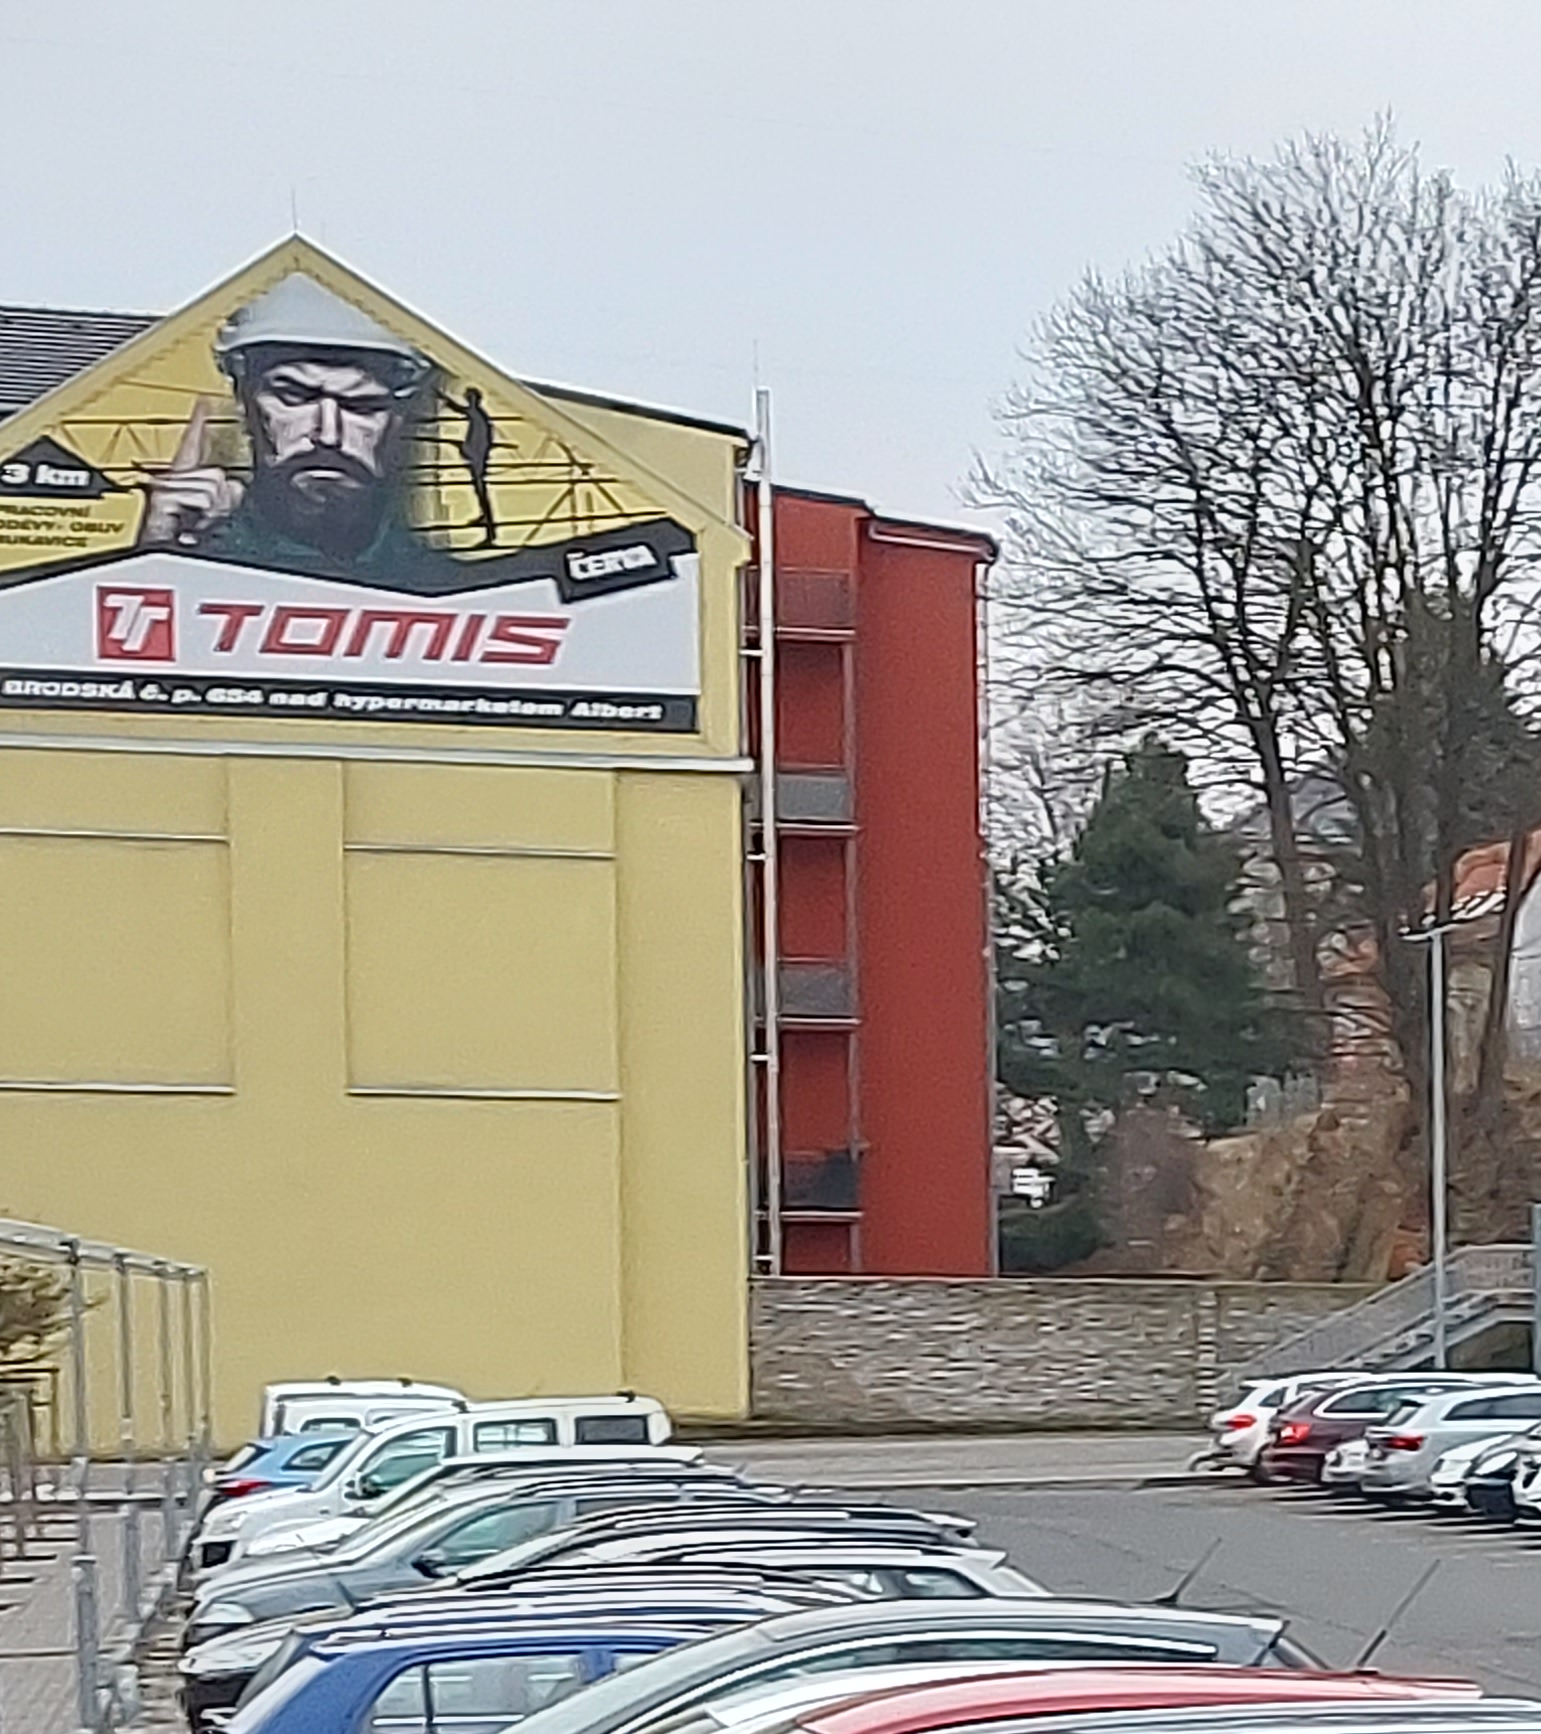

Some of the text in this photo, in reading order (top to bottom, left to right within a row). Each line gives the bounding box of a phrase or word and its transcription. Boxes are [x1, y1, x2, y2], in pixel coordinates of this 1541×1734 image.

[34, 463, 91, 486] km
[199, 603, 571, 664] TOMIS
[2, 679, 135, 700] BRODSKÁ
[171, 688, 201, 704] p.
[268, 691, 328, 707] nad
[332, 692, 565, 717] hypermarketem
[570, 700, 663, 720] Albert
